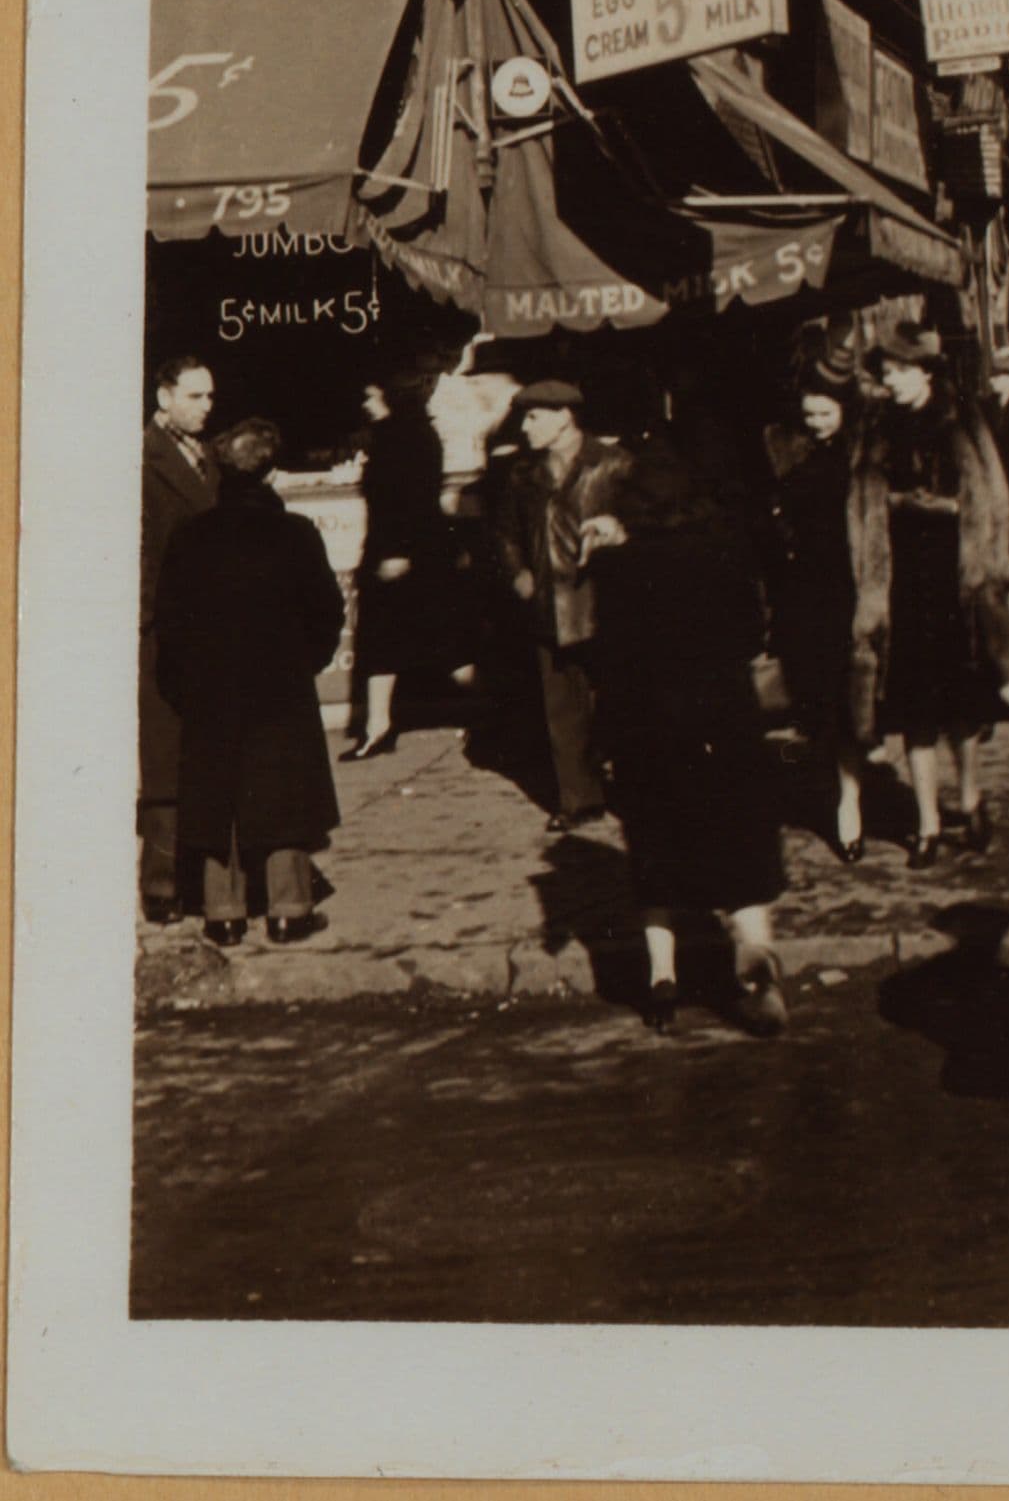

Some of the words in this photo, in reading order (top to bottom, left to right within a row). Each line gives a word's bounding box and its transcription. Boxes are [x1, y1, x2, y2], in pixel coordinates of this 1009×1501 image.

[584, 20, 649, 63] CREAM
[212, 182, 291, 221] 795
[218, 297, 256, 341] 5¢
[260, 296, 335, 326] MILK
[339, 289, 381, 335] 5¢
[505, 284, 645, 322] MALTED
